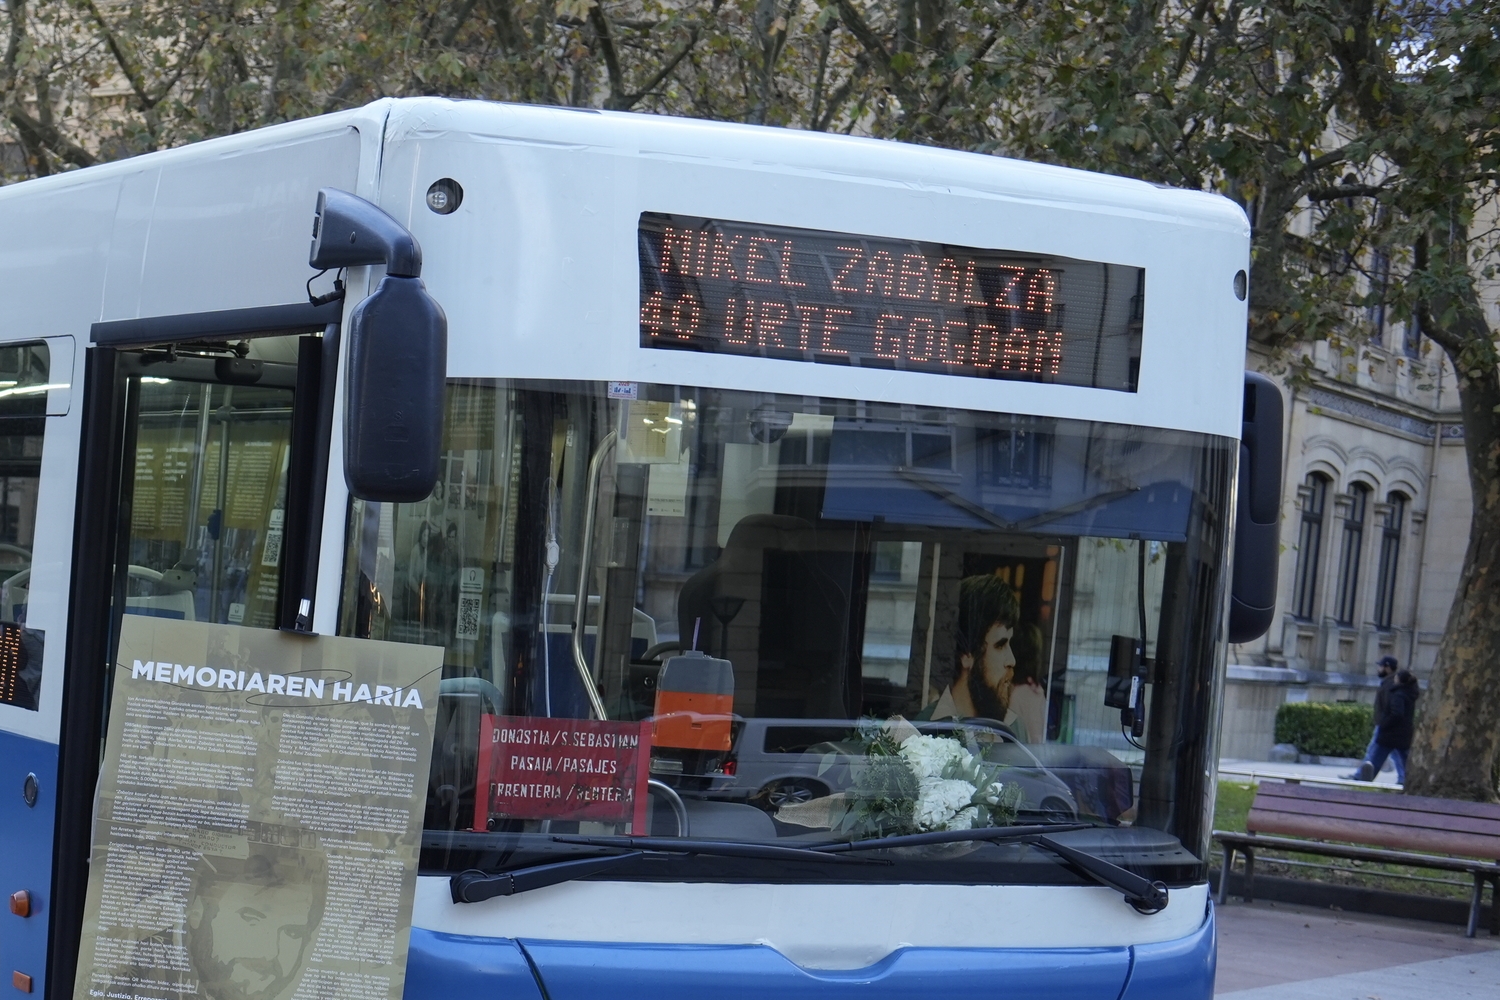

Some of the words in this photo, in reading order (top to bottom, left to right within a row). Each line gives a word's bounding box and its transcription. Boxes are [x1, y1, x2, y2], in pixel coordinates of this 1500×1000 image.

[660, 227, 806, 286] MIKEL
[832, 246, 1055, 312] ZABALZA
[640, 290, 699, 339] 40
[725, 298, 851, 354] URTE
[874, 313, 1062, 374] GOGOAN
[131, 659, 324, 699] MEMORIAREN
[332, 680, 423, 709] HARIA
